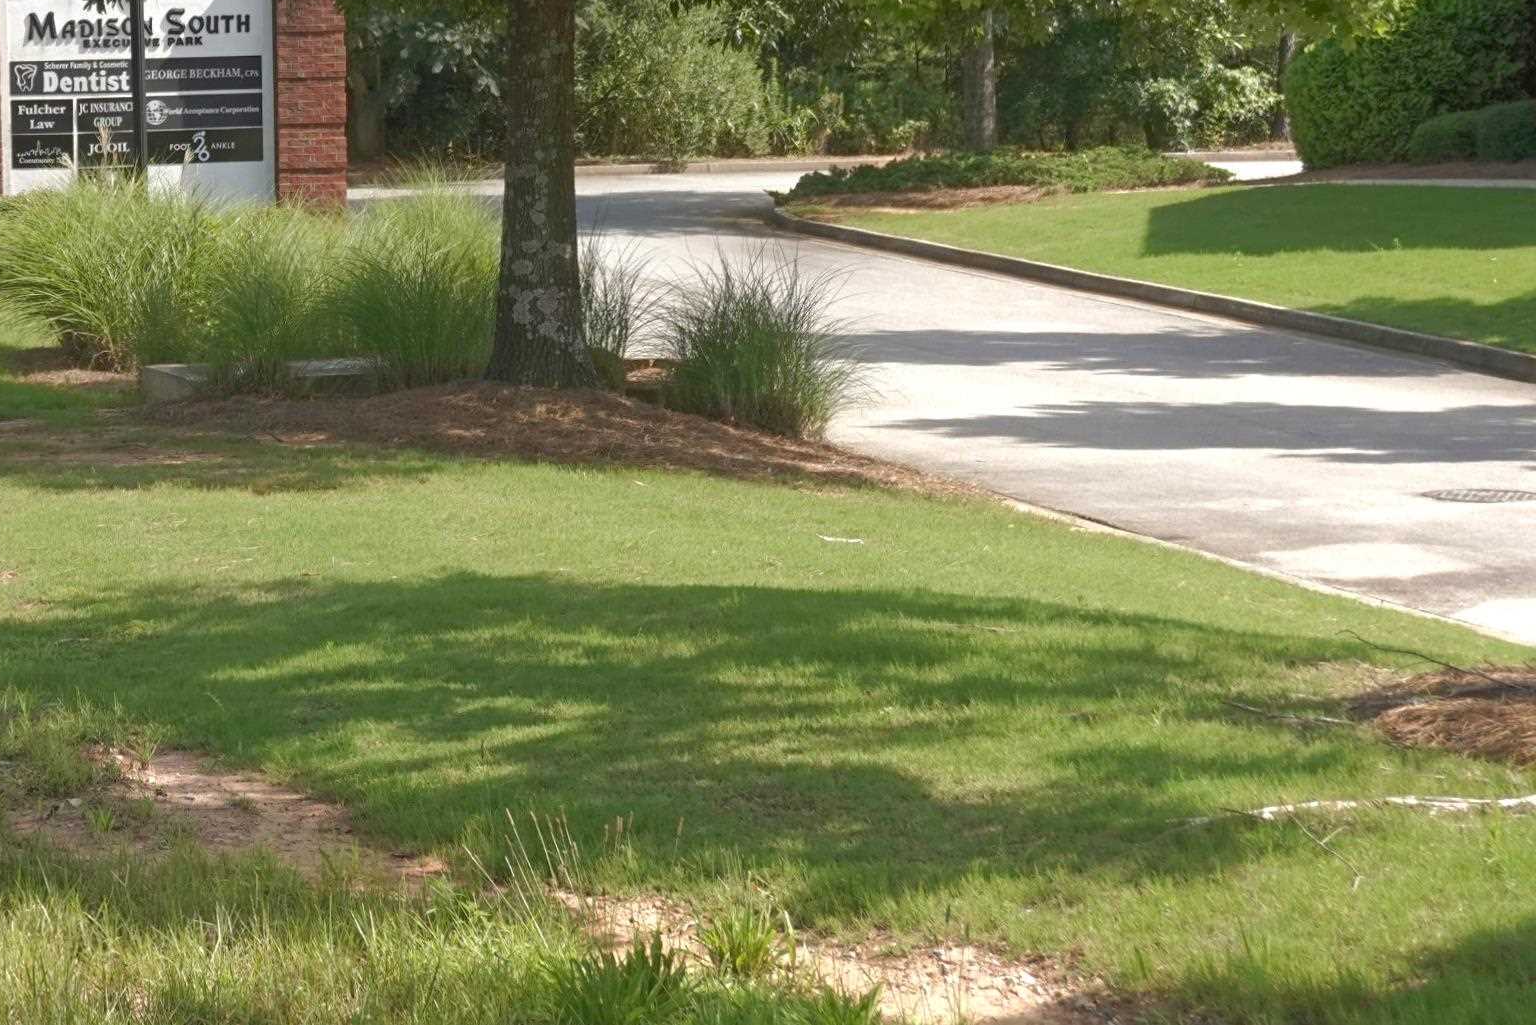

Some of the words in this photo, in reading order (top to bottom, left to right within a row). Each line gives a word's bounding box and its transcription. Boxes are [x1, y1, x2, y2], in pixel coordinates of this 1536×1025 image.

[26, 11, 154, 39] MADISON
[166, 8, 251, 35] SOUTH
[84, 36, 161, 48] EXECUVE
[167, 36, 203, 46] PARK
[44, 62, 69, 70] Scherer
[70, 62, 91, 71] Family
[189, 67, 244, 79] BECKHAM,
[43, 70, 130, 92] Dentist
[17, 104, 67, 115] Fulcher
[78, 103, 89, 116] JC
[220, 105, 260, 115] Corporation
[29, 119, 56, 130] Law
[93, 116, 123, 127] GROUP
[107, 142, 130, 153] OIL
[169, 143, 191, 151] FOOT
